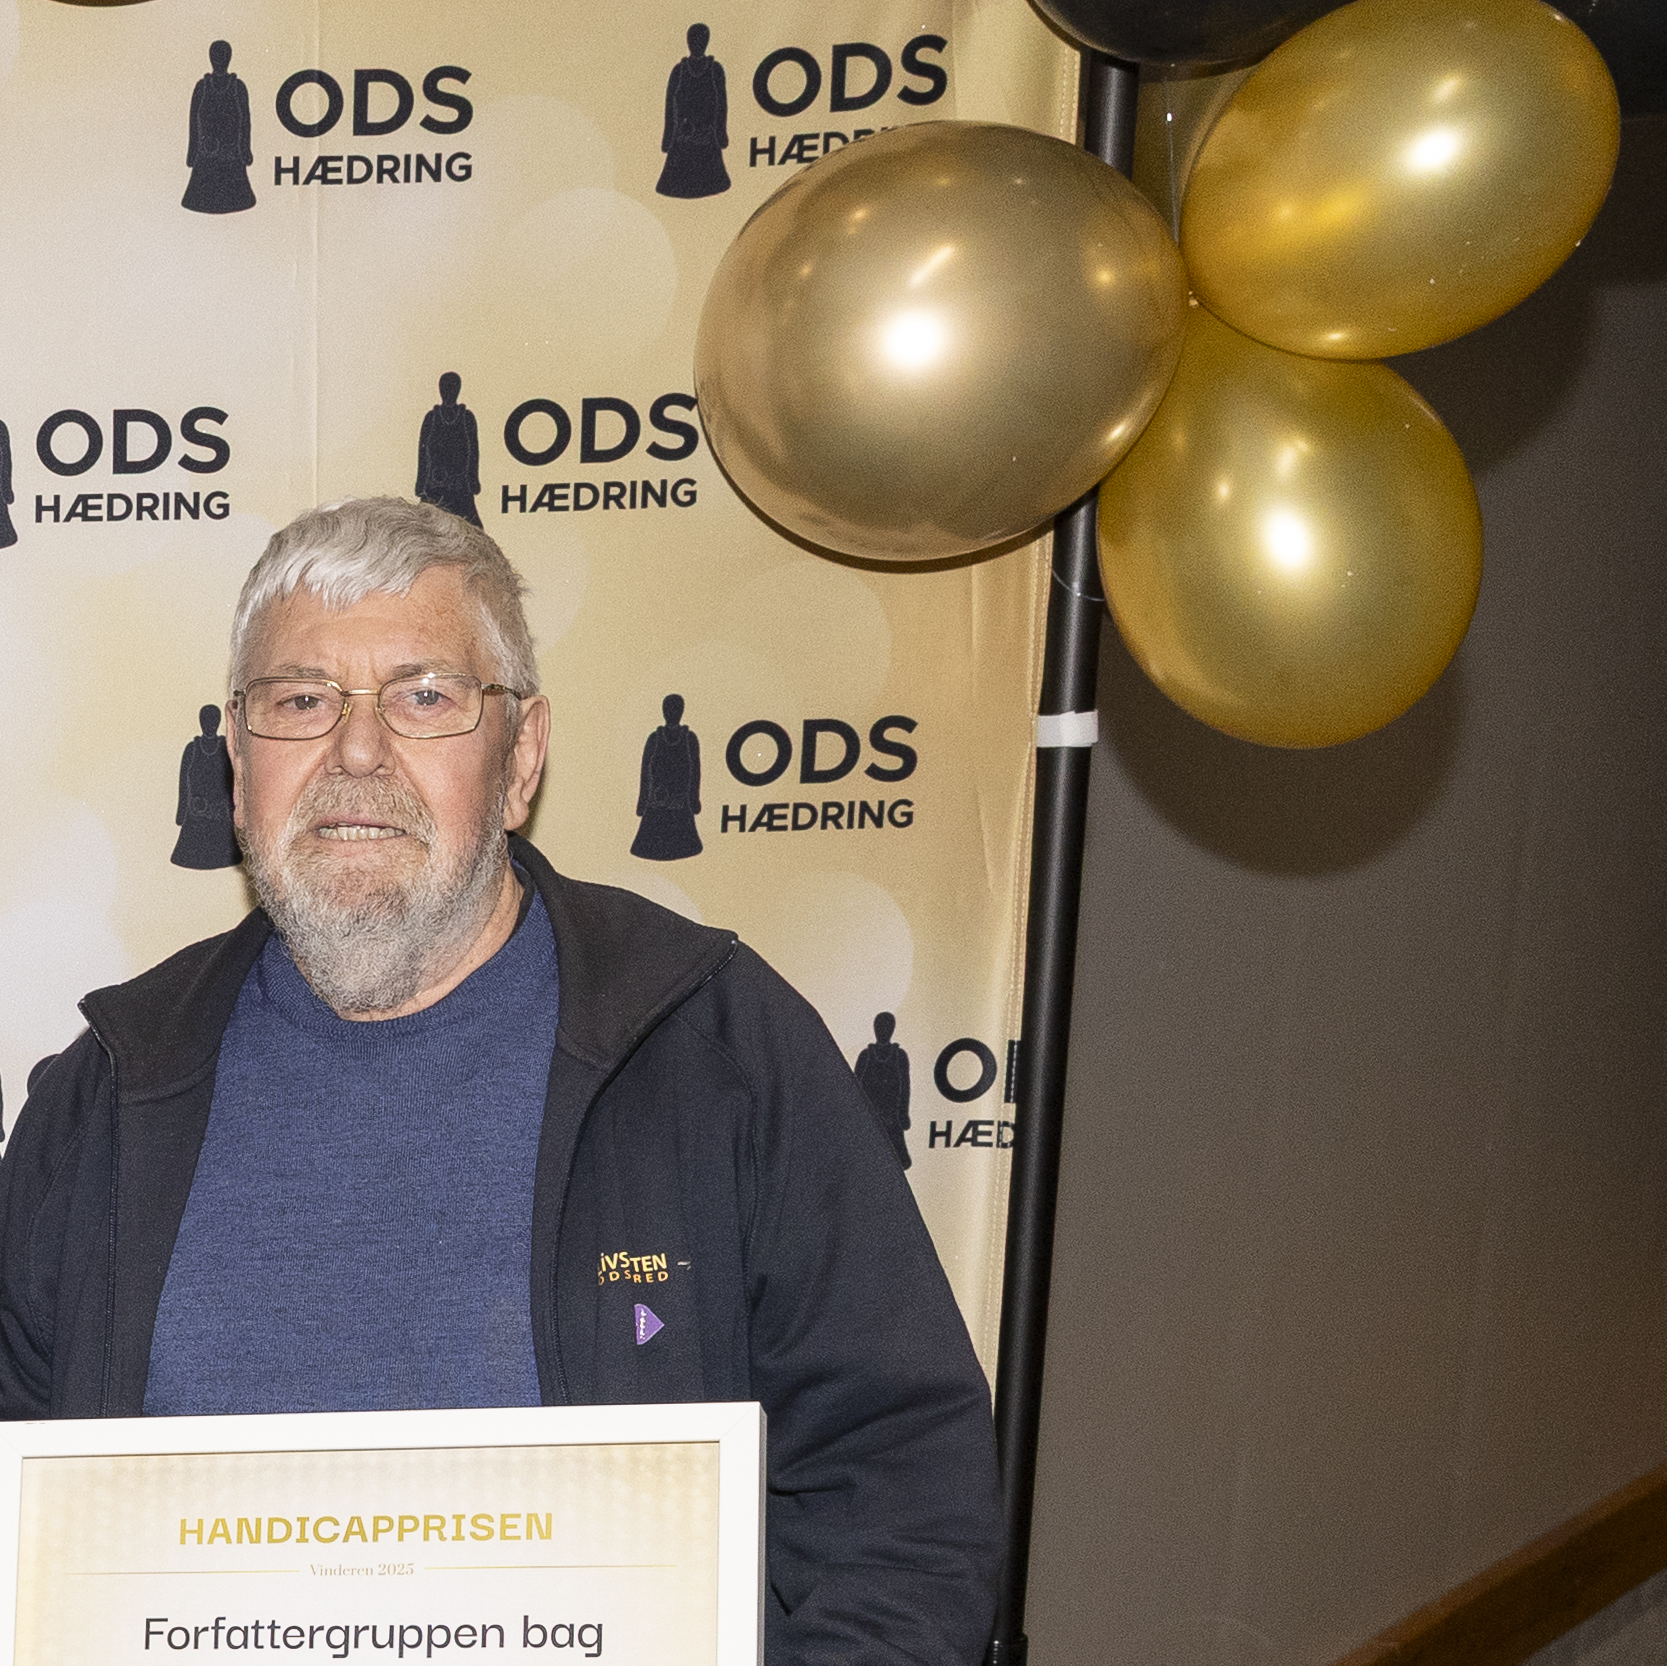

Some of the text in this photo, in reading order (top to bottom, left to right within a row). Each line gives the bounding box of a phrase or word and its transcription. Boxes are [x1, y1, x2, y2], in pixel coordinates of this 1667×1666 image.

[753, 34, 948, 117] ODS
[276, 66, 473, 137] ODS
[275, 152, 472, 185] HÆDRING
[37, 407, 230, 476] ODS
[504, 393, 699, 466] ODS
[36, 491, 229, 523] HÆDRING
[502, 478, 698, 513] HÆDRING
[726, 715, 917, 786] ODS
[721, 799, 913, 833] HÆDRING
[179, 1512, 553, 1545] HANDICAPPRISEN
[310, 1563, 415, 1577] Vinderen 2025
[145, 1615, 603, 1659] Forfattergruppen bag
